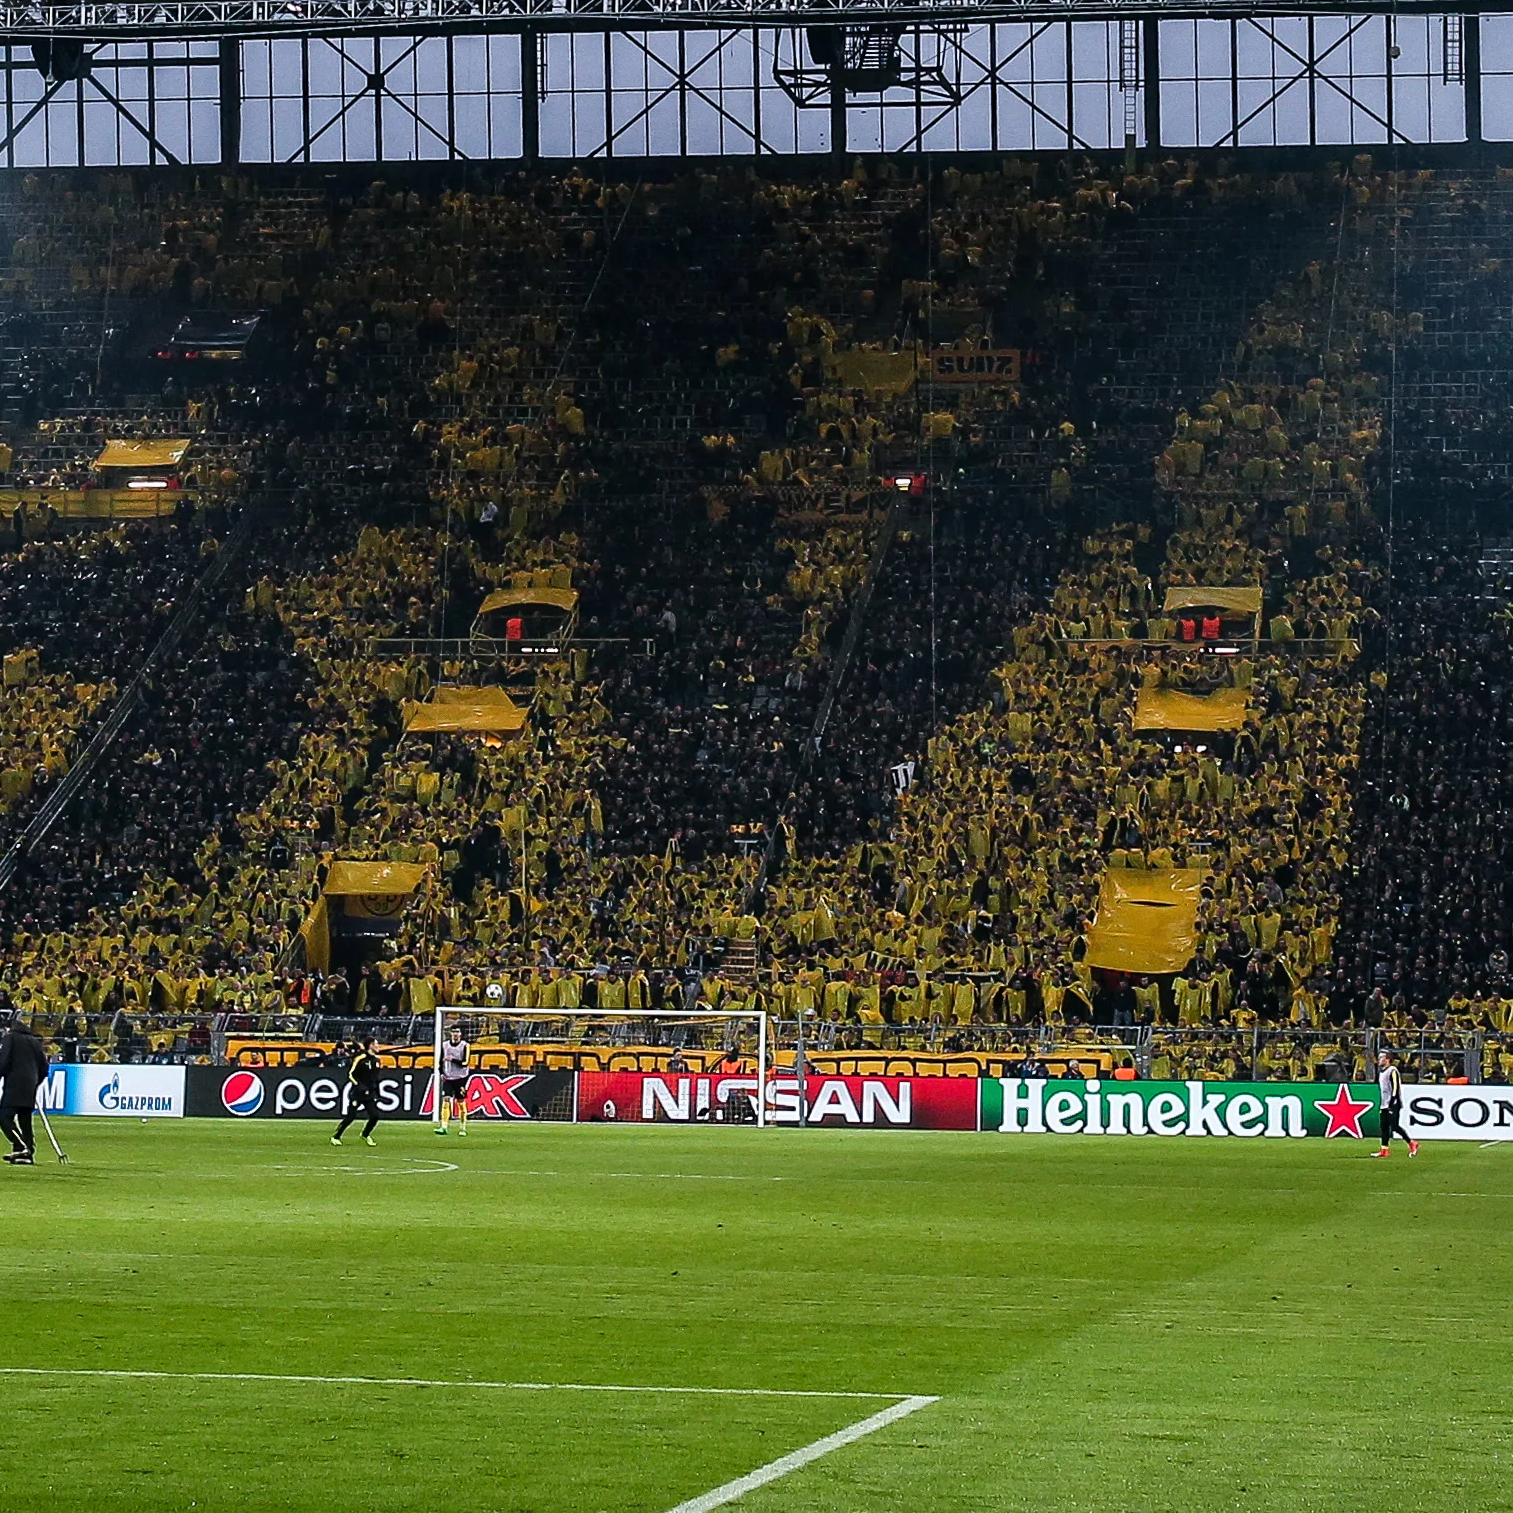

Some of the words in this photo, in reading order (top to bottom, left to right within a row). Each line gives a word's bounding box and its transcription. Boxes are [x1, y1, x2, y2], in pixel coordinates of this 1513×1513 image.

[120, 1097, 172, 1111] GAZPROM
[419, 1074, 537, 1118] AX
[641, 1077, 912, 1123] NISSAN
[998, 1078, 1308, 1138] Heineken
